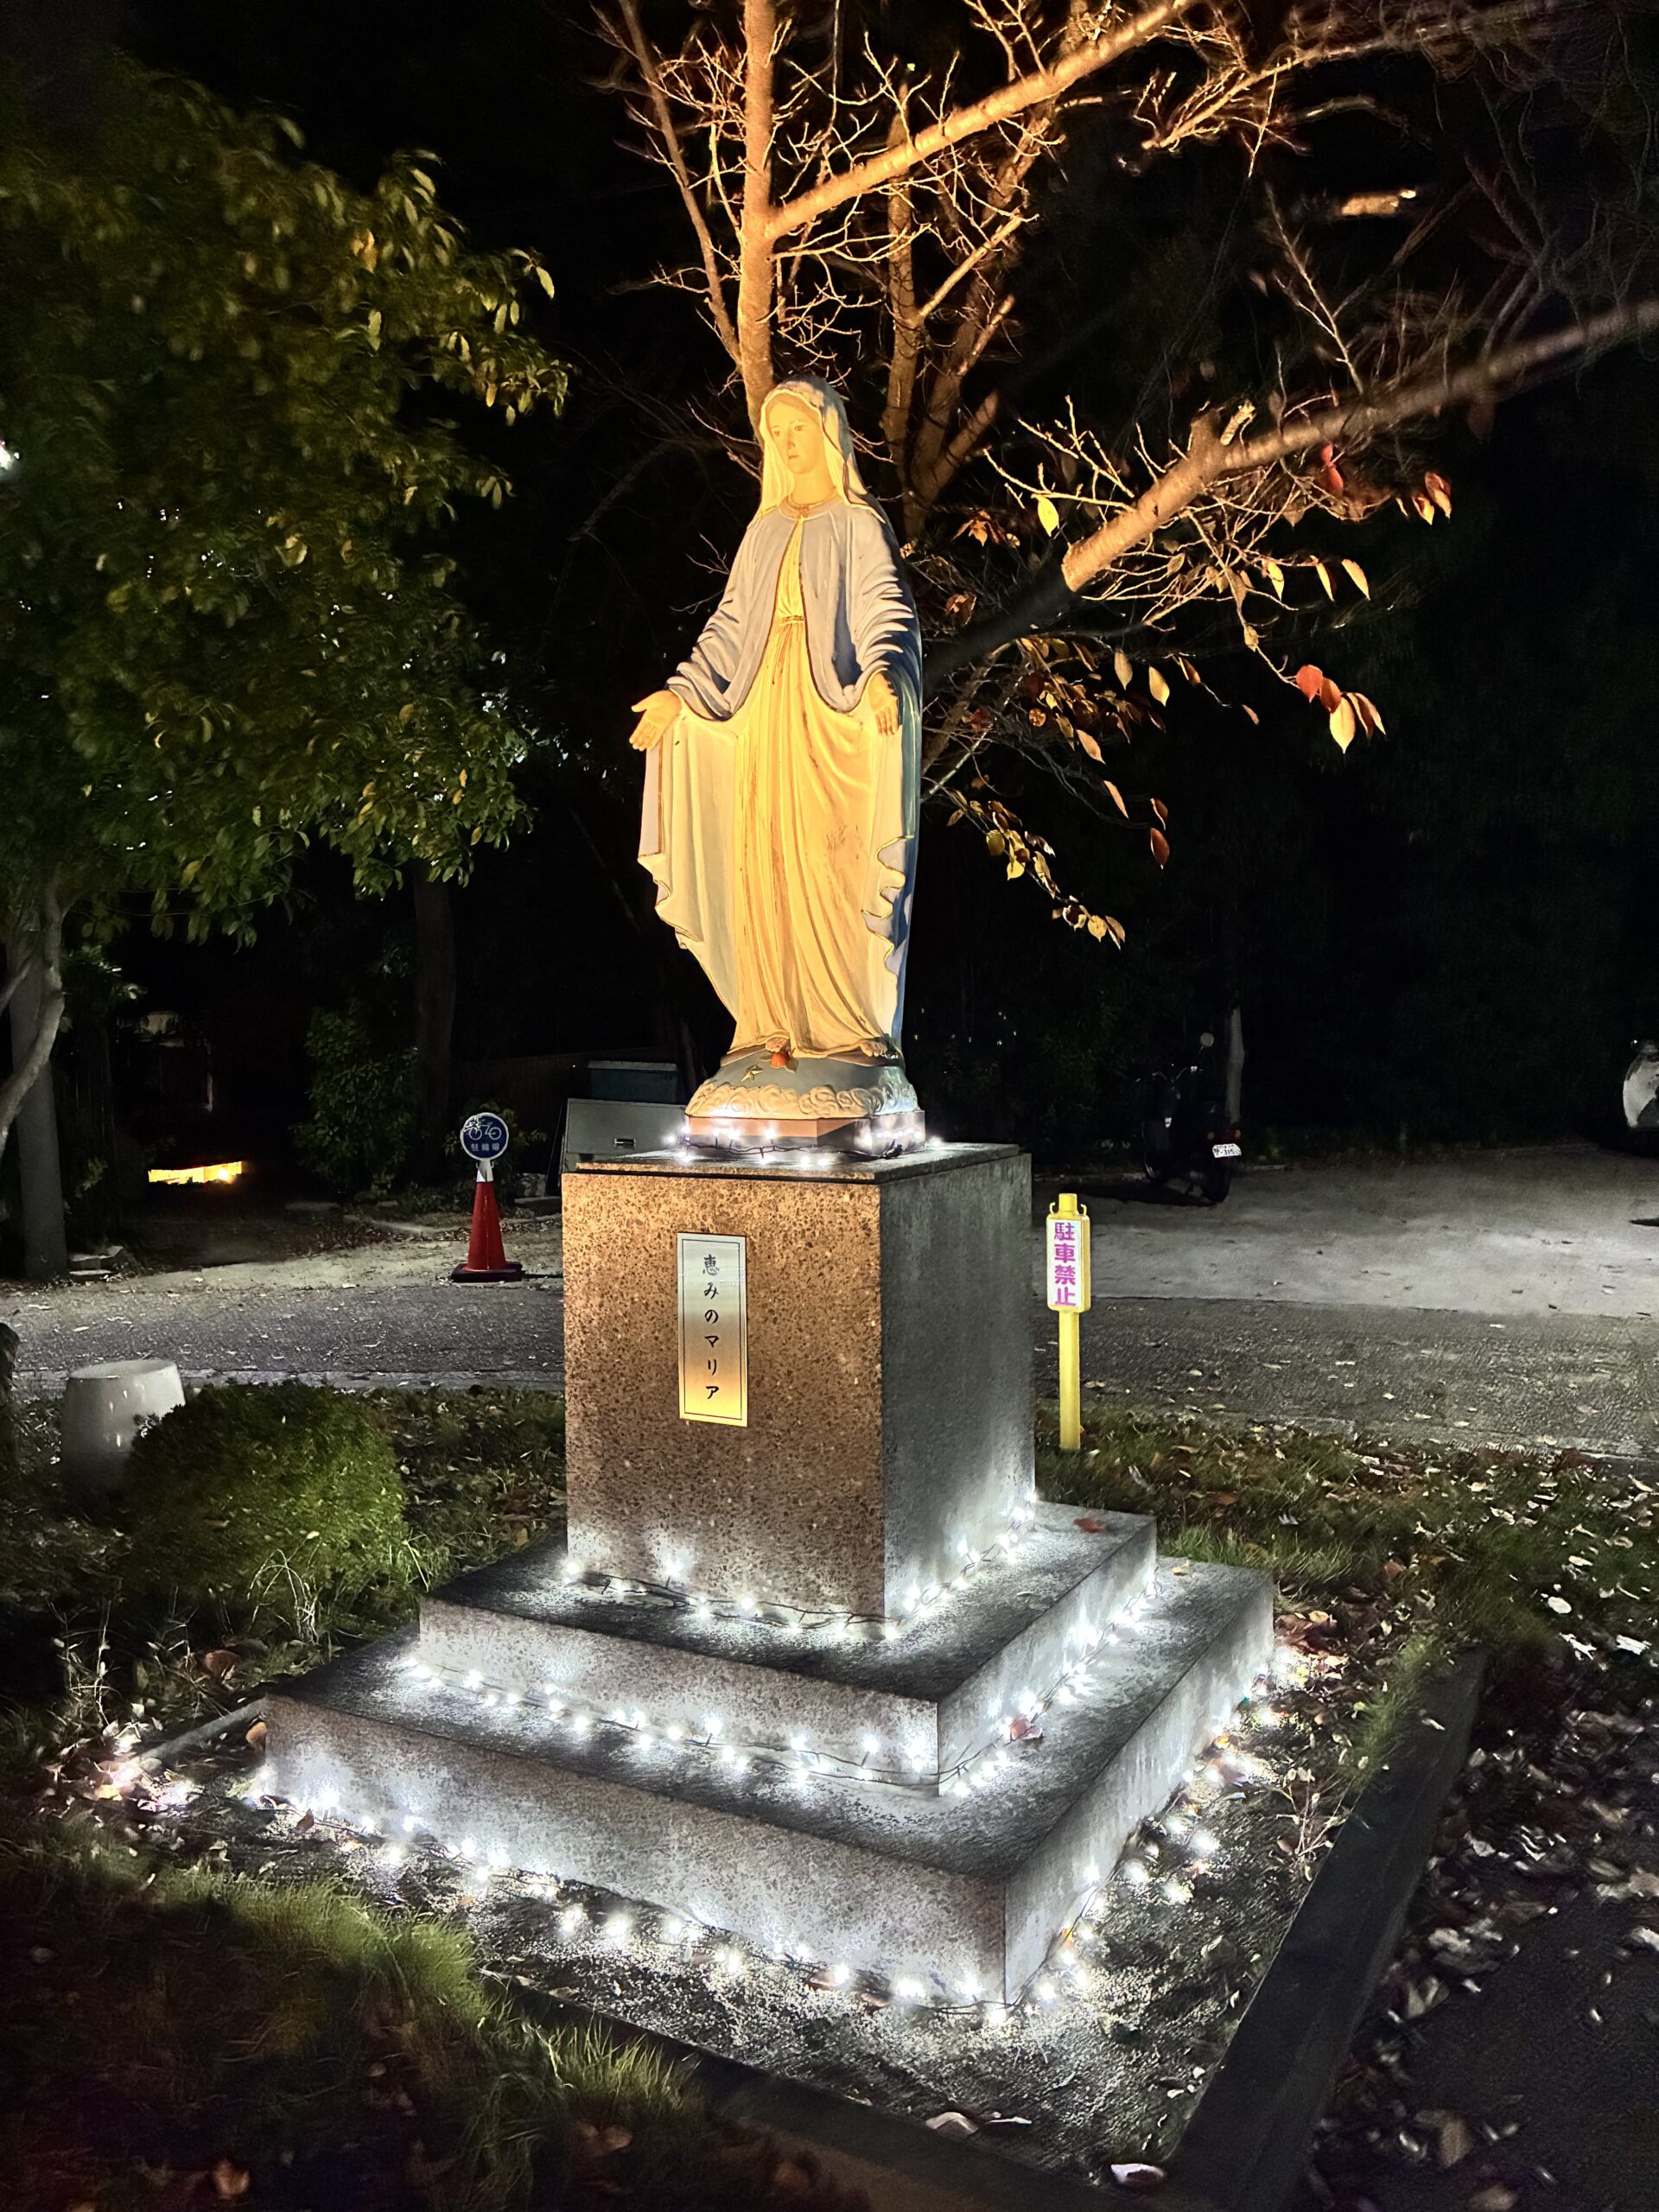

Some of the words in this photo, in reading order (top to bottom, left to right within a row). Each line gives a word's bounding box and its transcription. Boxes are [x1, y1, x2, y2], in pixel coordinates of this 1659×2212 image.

[1054, 1222, 1076, 1306] 駐車禁止
[702, 1254, 720, 1400] 恵みのマリア
